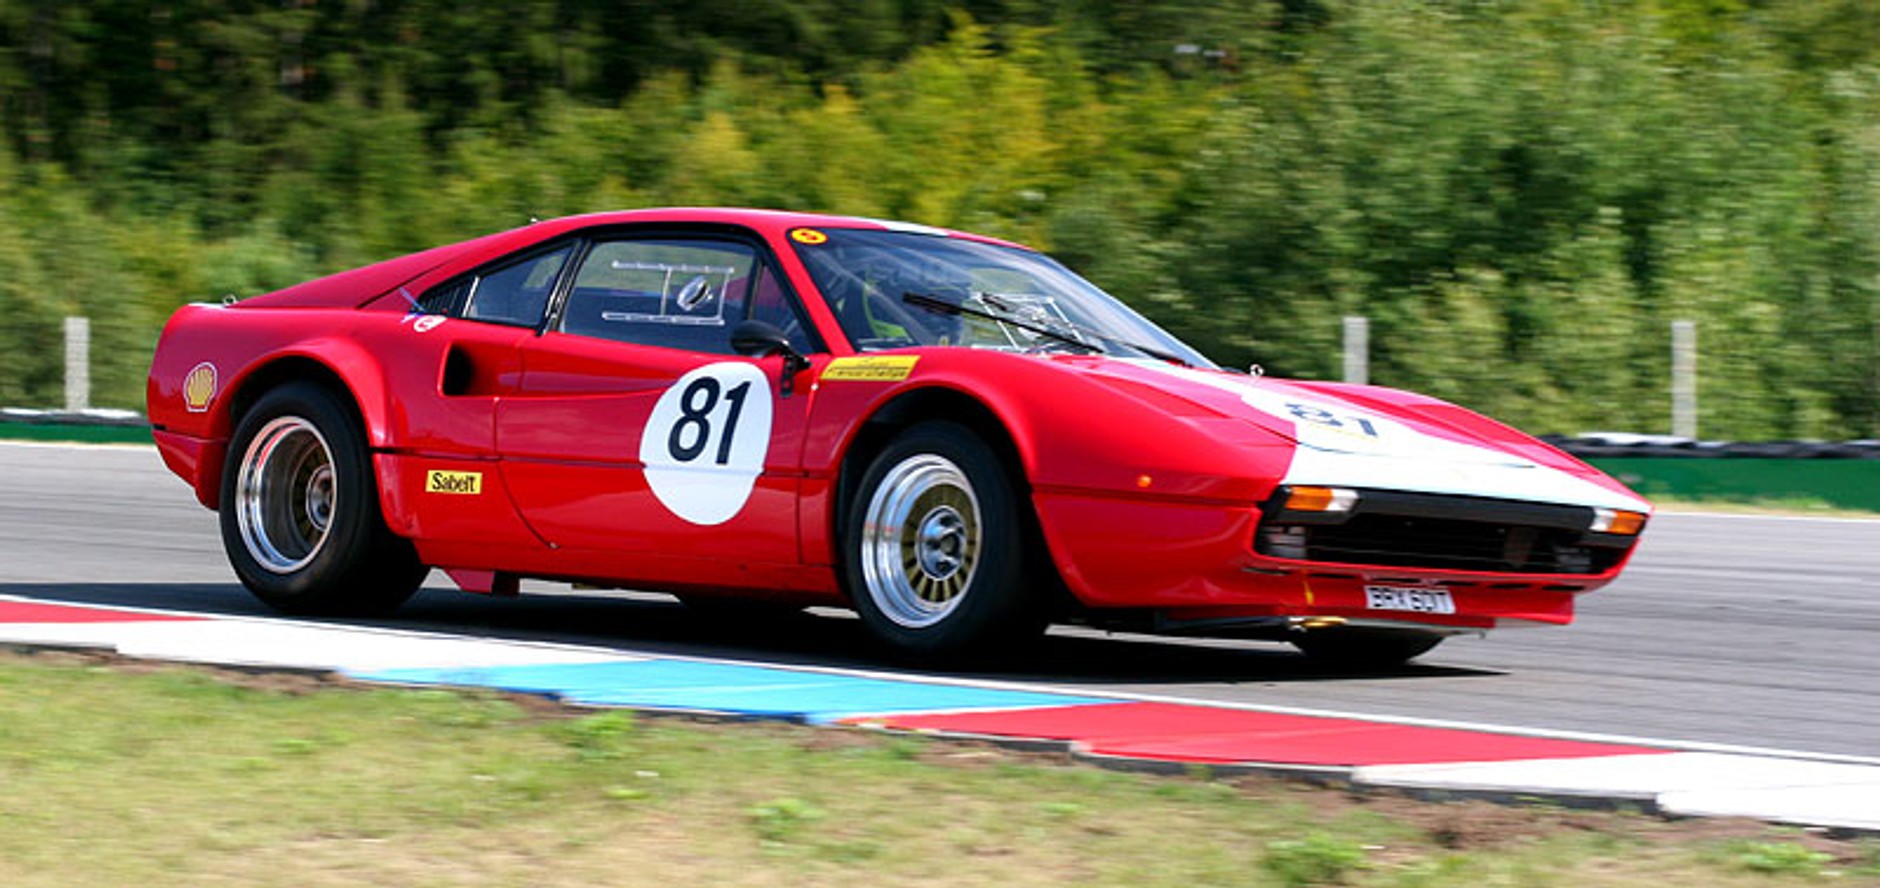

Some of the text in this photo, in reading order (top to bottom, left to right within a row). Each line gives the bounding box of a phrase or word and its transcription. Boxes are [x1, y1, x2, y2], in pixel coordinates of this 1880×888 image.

[668, 376, 751, 464] 81
[1285, 402, 1378, 437] 81
[432, 472, 475, 492] Sabelt
